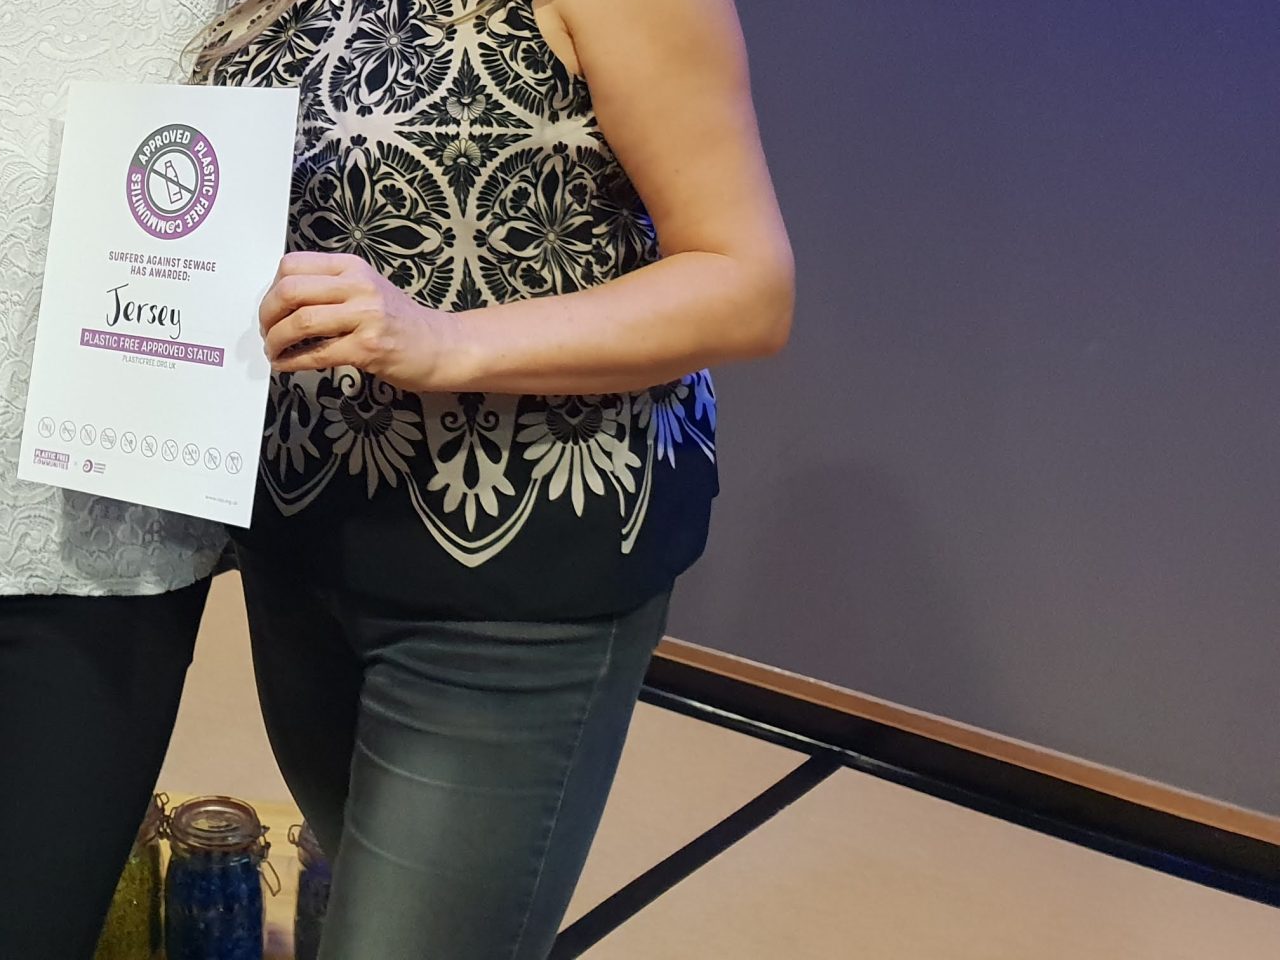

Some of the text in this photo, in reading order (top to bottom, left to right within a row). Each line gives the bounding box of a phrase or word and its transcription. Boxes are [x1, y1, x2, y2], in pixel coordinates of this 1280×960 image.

[130, 128, 216, 234] APPROVED PLASTIC FREE COMMUNITIES
[108, 250, 216, 272] SURFERS AGAINST SEWAGE
[130, 264, 191, 282] HAS AWARDED:
[106, 283, 182, 340] Jersey
[84, 332, 220, 363] PLASTIC FREE APPROVED STATUS
